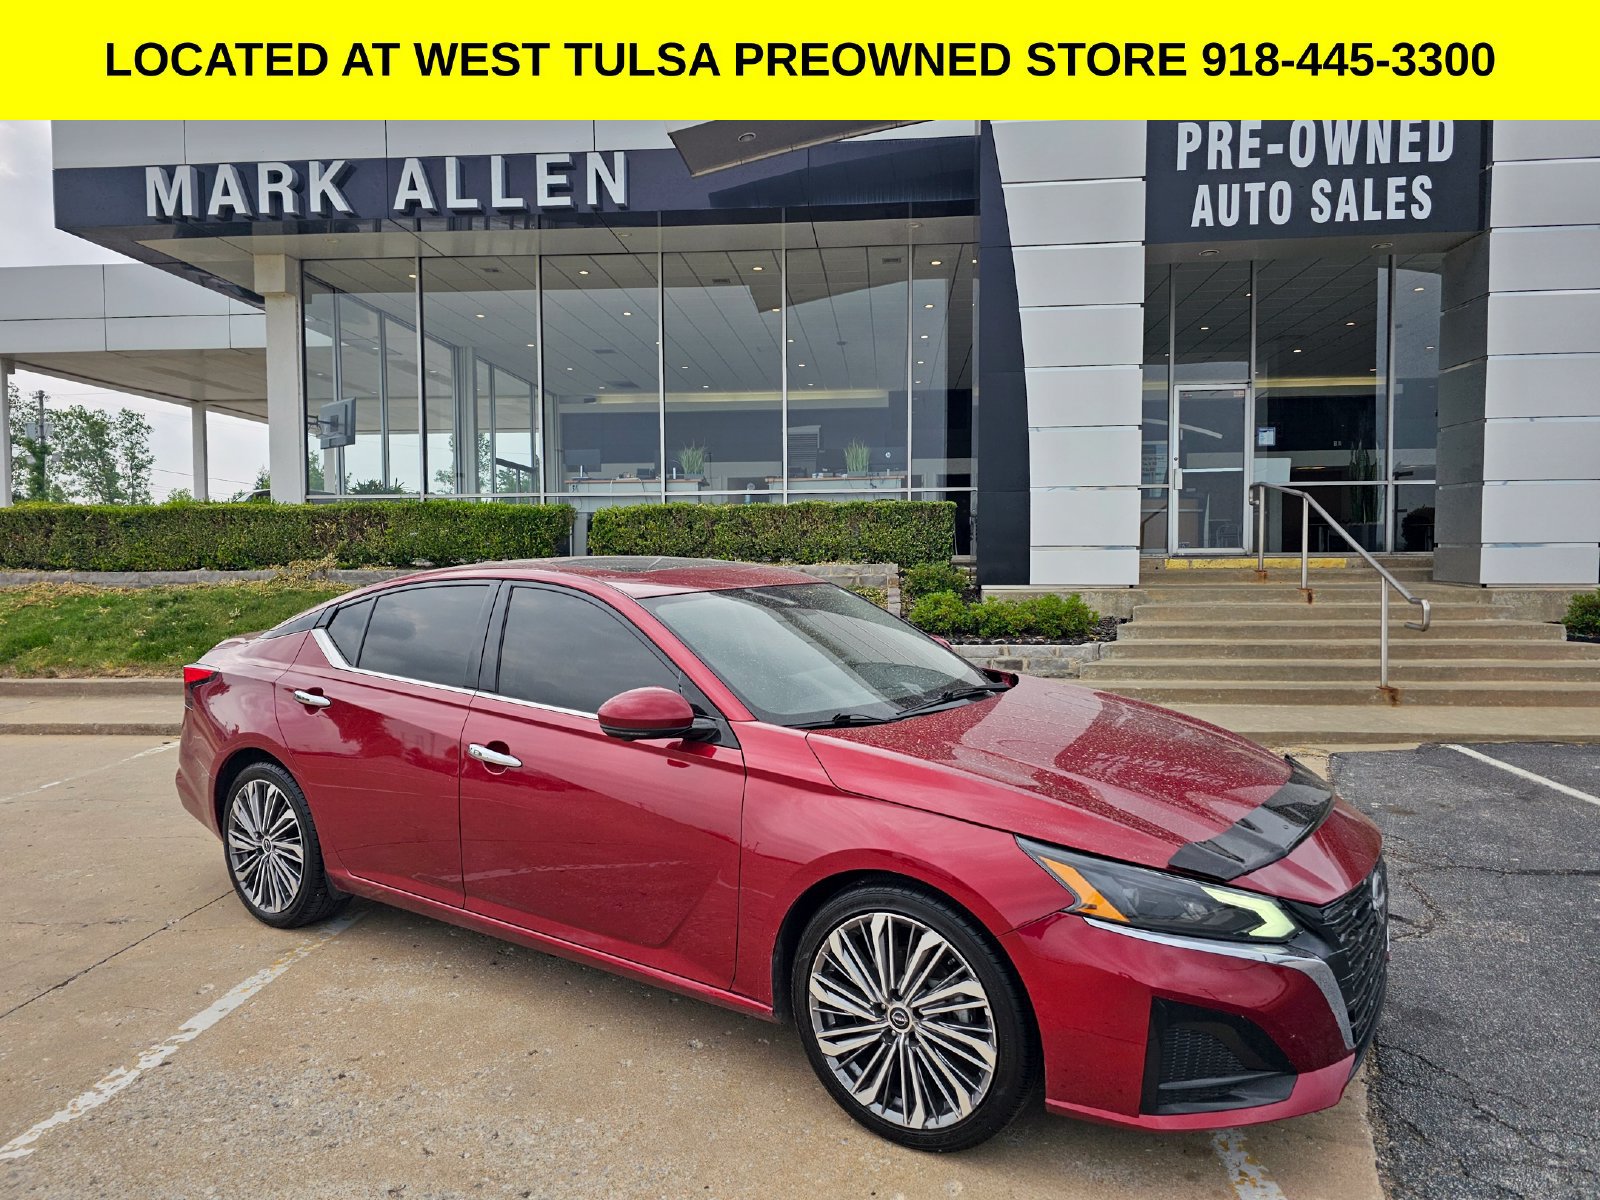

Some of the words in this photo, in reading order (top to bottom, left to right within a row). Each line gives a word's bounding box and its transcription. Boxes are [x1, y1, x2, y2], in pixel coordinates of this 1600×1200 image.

[1176, 119, 1454, 171] PRE-OWNED
[145, 160, 356, 219] MARK
[392, 151, 628, 214] ALLEN
[1190, 180, 1292, 227] AUTO
[1310, 175, 1433, 223] SALES
